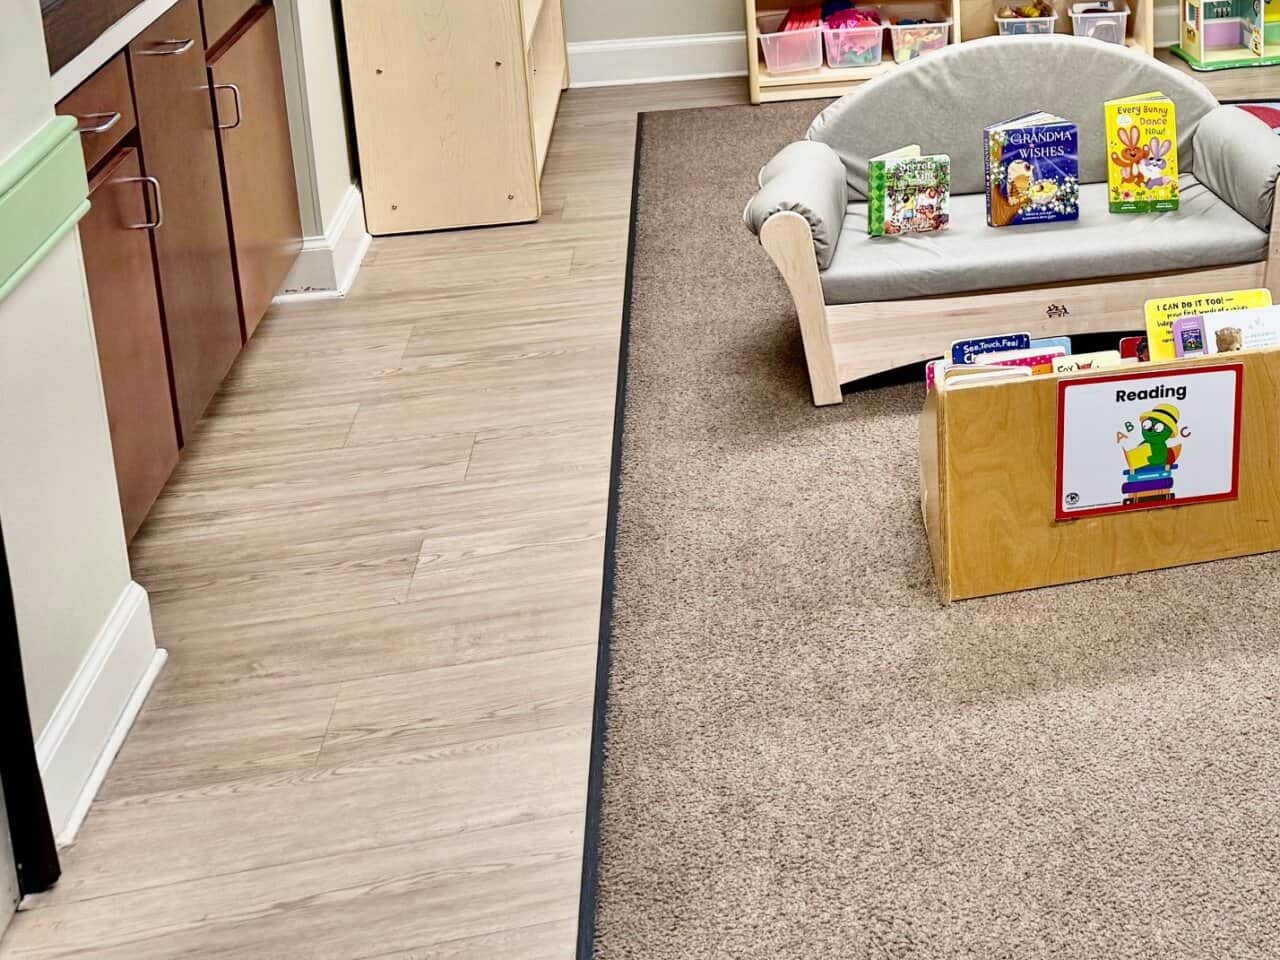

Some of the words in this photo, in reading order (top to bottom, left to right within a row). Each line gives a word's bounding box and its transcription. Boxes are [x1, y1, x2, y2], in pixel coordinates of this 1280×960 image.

[1117, 105, 1141, 116] Every
[1143, 105, 1168, 118] Bunny
[1140, 117, 1168, 126] Dance
[1010, 131, 1072, 145] GRANDMA
[1019, 145, 1065, 159] WISHES
[1162, 302, 1179, 311] CAN
[1195, 299, 1202, 307] IT
[1205, 296, 1224, 306] TOO!
[1115, 384, 1187, 403] Reading
[1116, 431, 1129, 444] A
[1124, 421, 1135, 433] B
[1180, 426, 1192, 438] C
